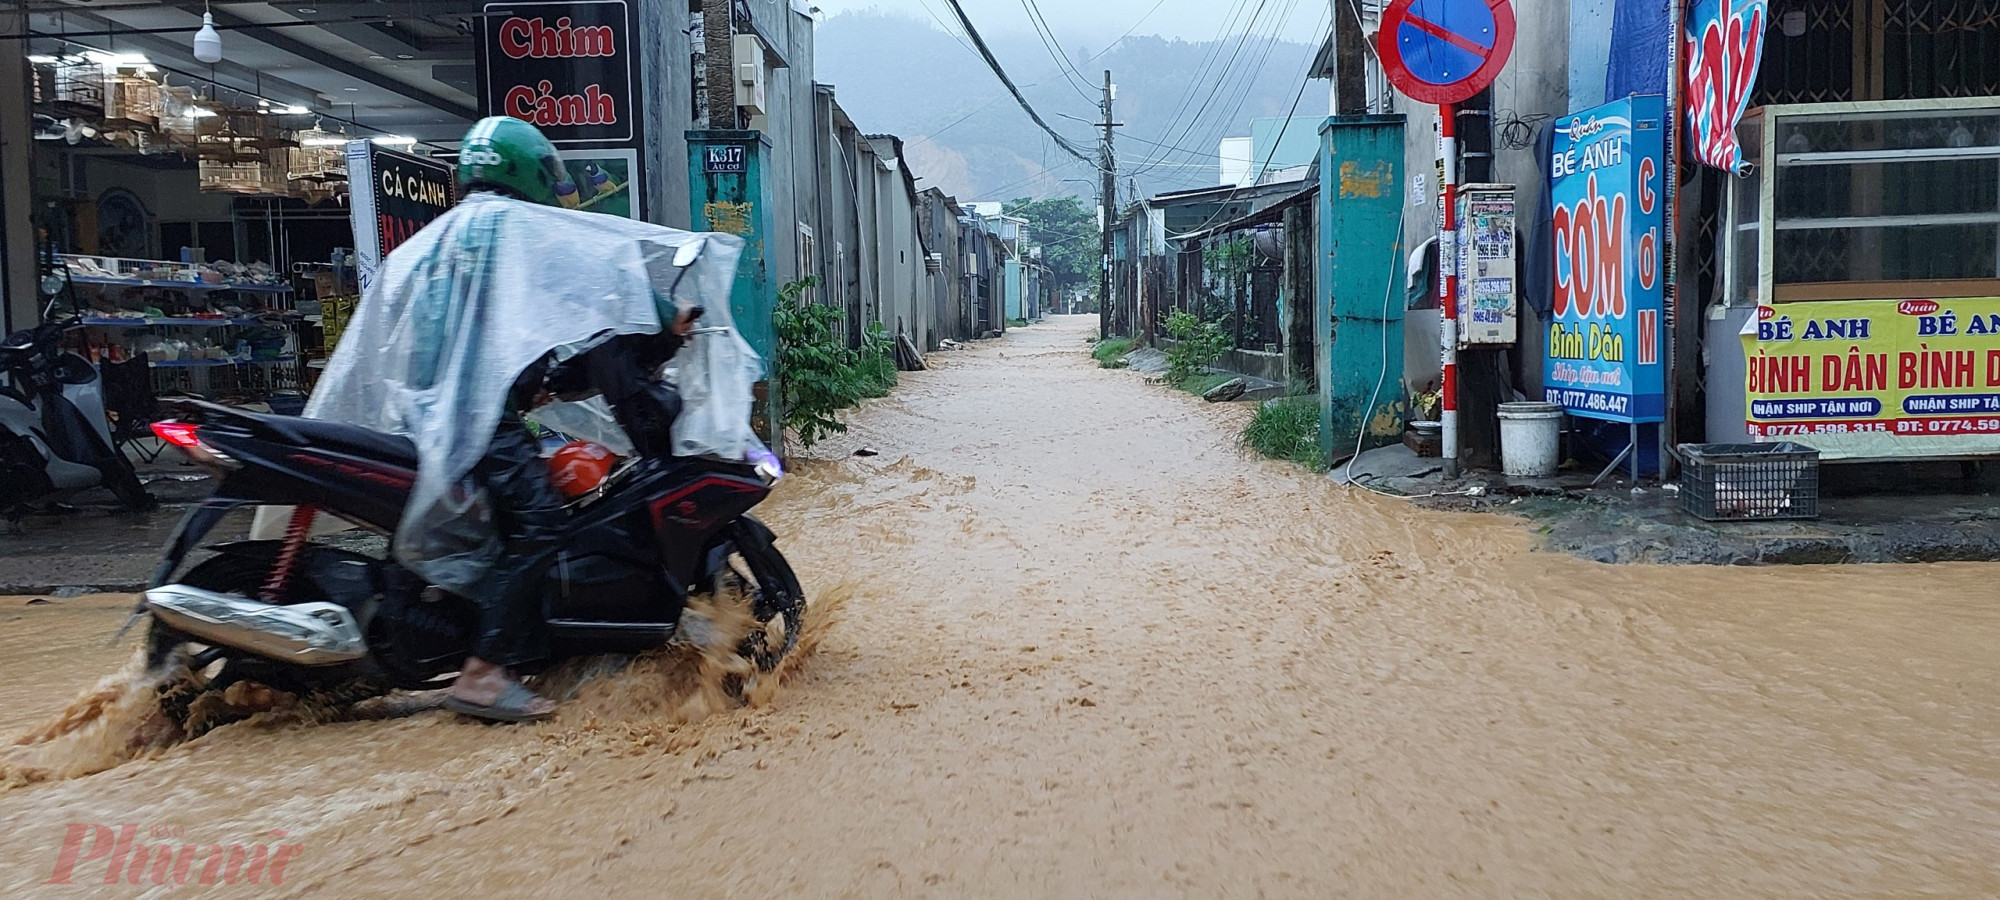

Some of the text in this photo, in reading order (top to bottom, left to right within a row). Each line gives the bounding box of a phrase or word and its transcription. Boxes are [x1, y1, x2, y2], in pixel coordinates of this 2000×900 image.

[499, 17, 615, 59] Chim
[504, 80, 617, 126] Cảnh
[1569, 115, 1604, 142] Quán
[709, 148, 742, 163] K317
[1552, 136, 1623, 178] BÉ ANH
[382, 166, 447, 208] CÁ CẢNH
[1553, 171, 1627, 320] CƠM
[1900, 301, 1937, 314] Quán
[1758, 315, 1871, 341] BÉ ANH
[1917, 309, 1958, 336] BÉ
[1549, 322, 1624, 362] Bình Dân
[1552, 362, 1578, 386] Ship
[1749, 346, 1888, 393] BÌNH DÂN
[1898, 343, 1975, 389] BÌNH
[1563, 390, 1628, 414] 0777.486.447
[1753, 400, 1873, 417] NHẬN SHIP TẬN NƠI
[1909, 397, 1947, 412] NHẬN
[1949, 398, 1980, 410] SHIP
[1767, 422, 1886, 436] 0774.598.315
[1897, 420, 1923, 432] ĐT:
